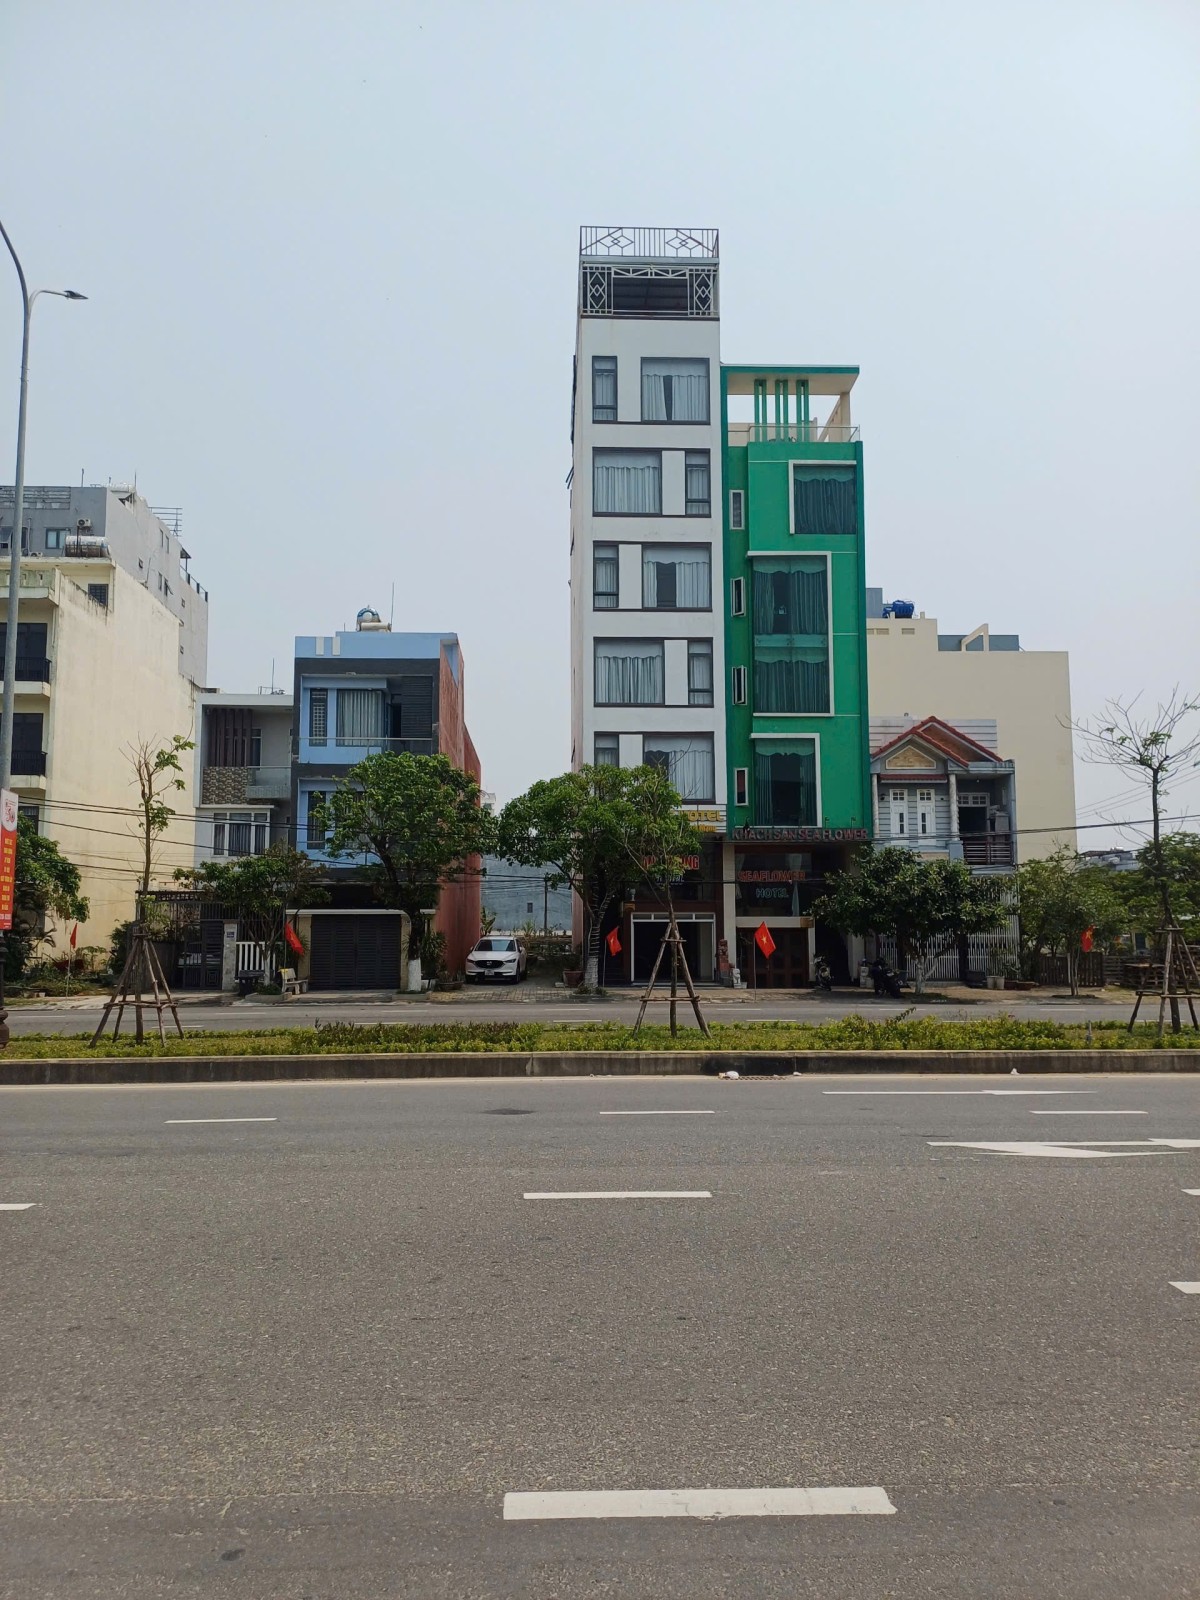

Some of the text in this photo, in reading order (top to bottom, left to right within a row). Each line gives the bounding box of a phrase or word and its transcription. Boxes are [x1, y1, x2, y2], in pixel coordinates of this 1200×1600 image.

[798, 828, 820, 841] SEA
[822, 828, 868, 841] FLOWER
[738, 869, 806, 882] SEAFLOWER
[756, 887, 789, 898] HOTEL
